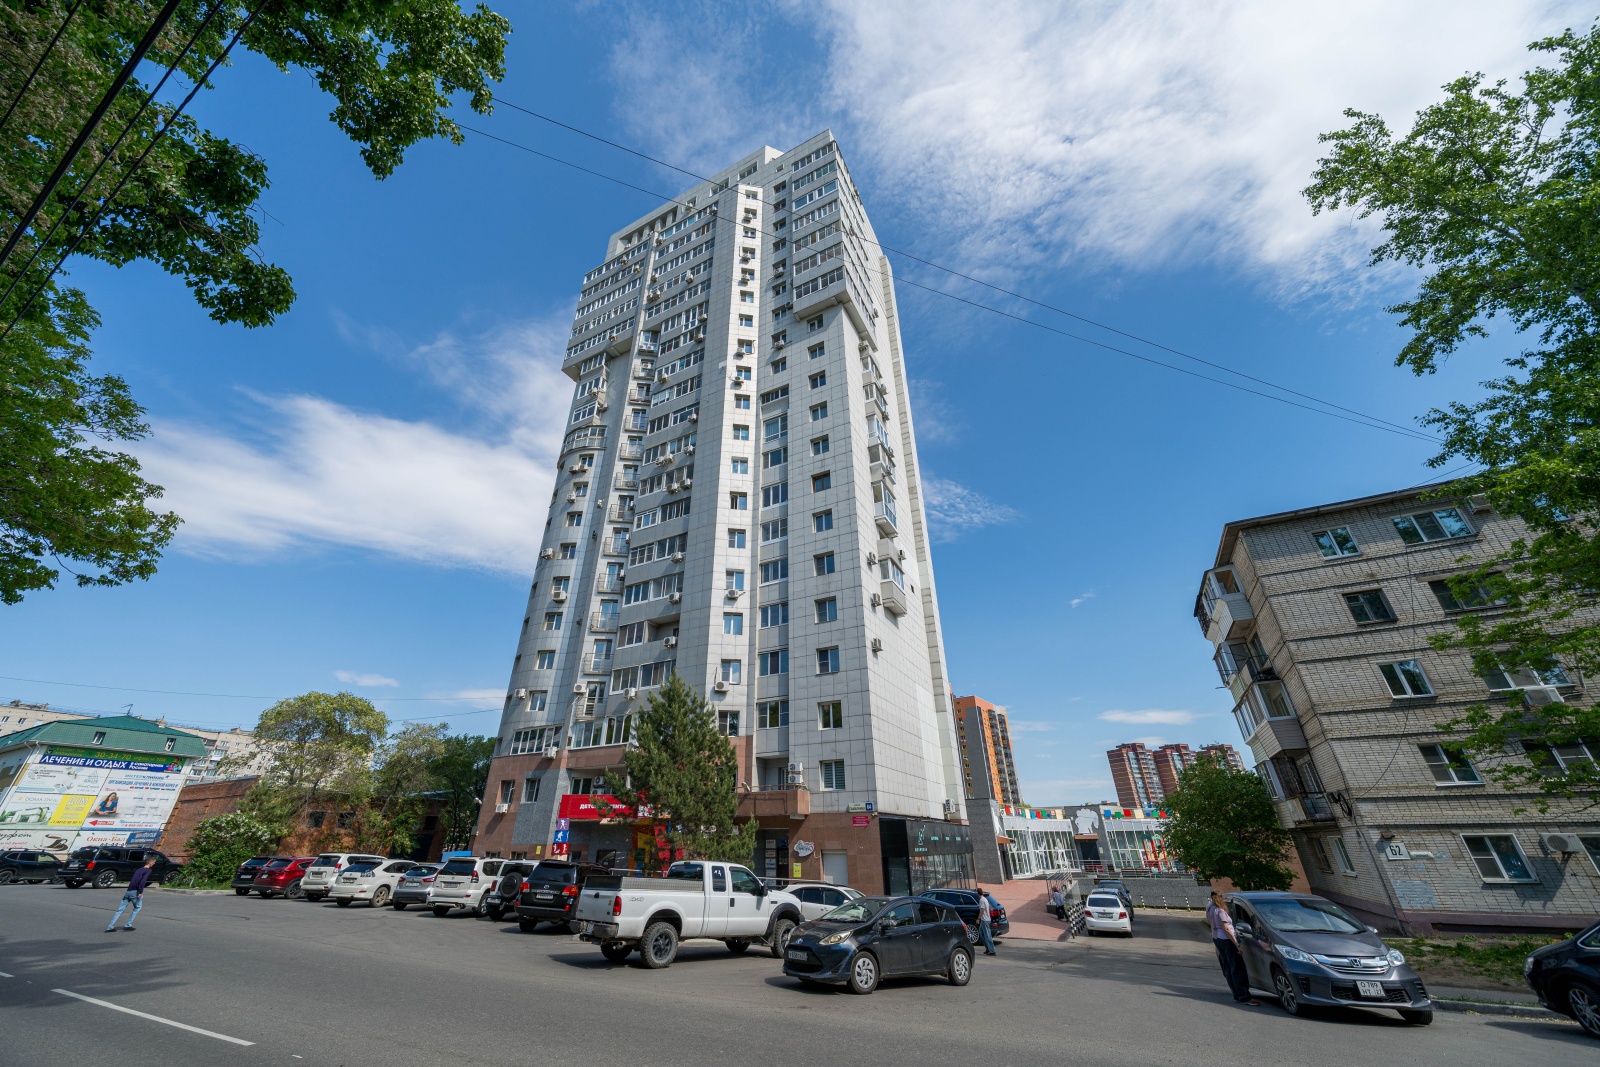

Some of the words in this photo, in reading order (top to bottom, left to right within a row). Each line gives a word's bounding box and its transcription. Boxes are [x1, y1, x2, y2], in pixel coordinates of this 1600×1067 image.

[41, 756, 85, 766] ЛЕЧЕНИЕ
[94, 760, 128, 768] ОТДЫХ
[1389, 845, 1403, 856] 62
